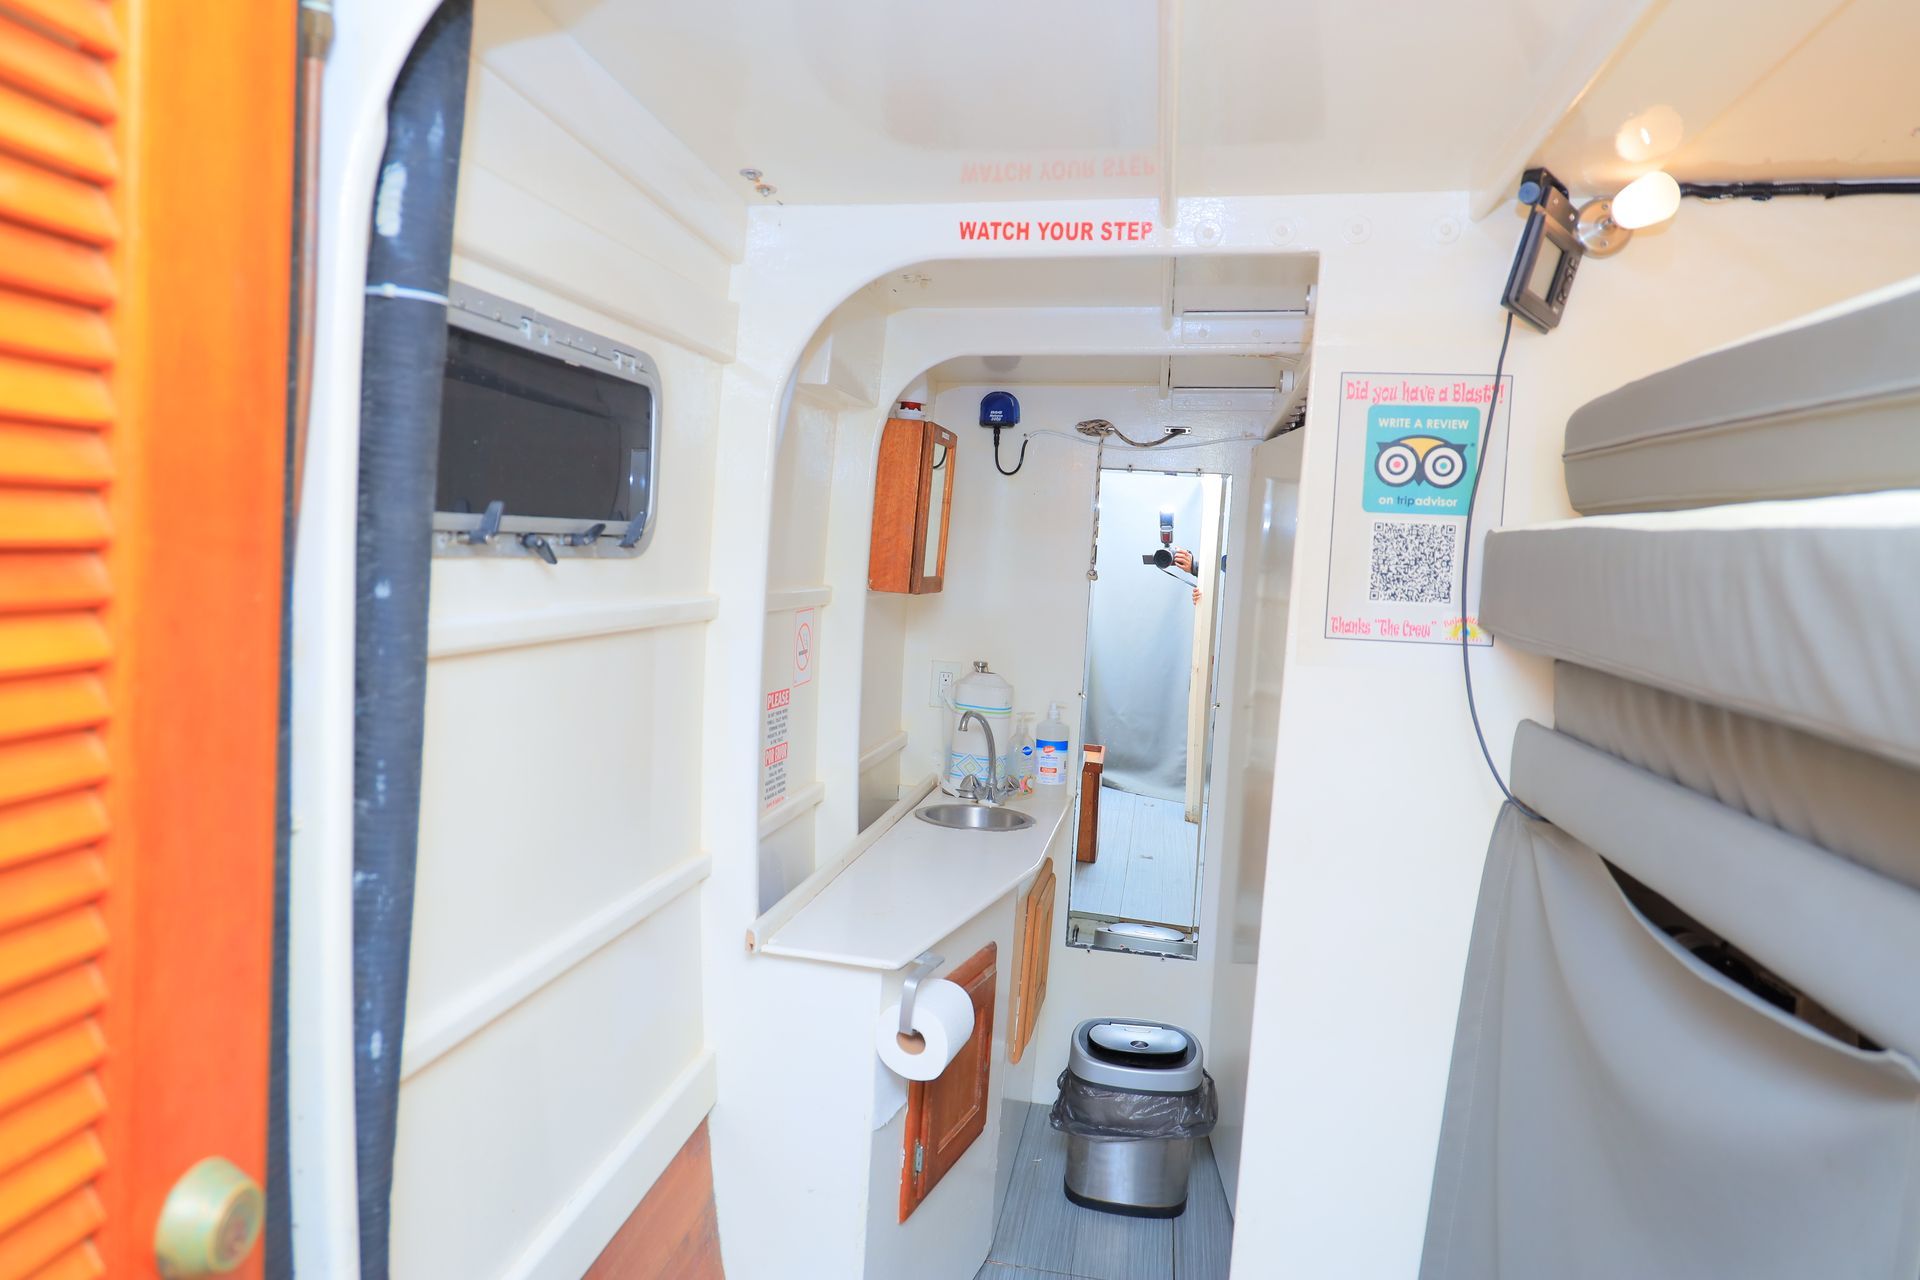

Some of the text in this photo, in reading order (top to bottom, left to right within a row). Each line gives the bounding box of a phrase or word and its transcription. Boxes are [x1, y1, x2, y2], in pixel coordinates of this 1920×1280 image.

[959, 221, 1154, 241] WATCH YOUR STEP
[1346, 380, 1369, 401] Did
[1372, 384, 1398, 405] you
[1402, 381, 1434, 403] have
[1439, 384, 1449, 402] a
[1378, 417, 1470, 430] WRITE A REVIEW
[1378, 495, 1459, 509] on tripadvisor
[1330, 616, 1371, 636] Thanks
[767, 689, 790, 709] PLEASE
